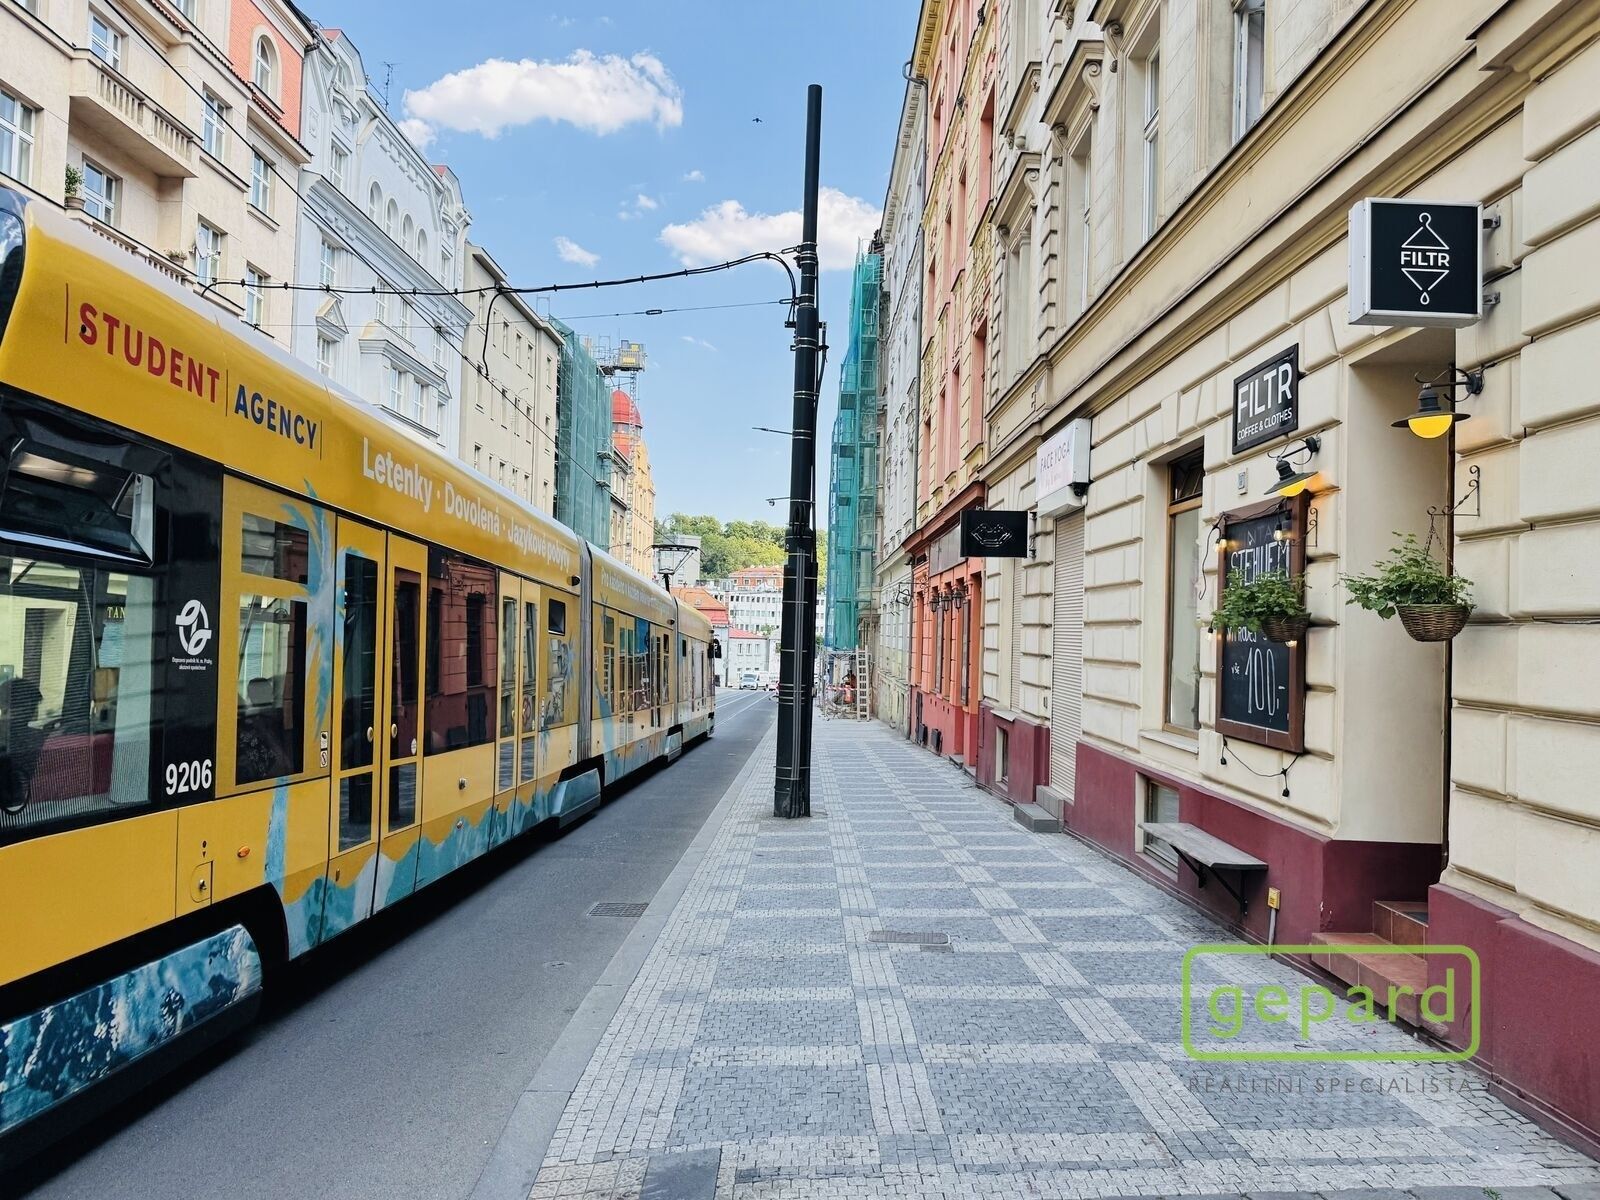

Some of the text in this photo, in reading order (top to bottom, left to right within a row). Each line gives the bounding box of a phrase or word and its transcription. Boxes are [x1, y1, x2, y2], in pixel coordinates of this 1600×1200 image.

[1400, 251, 1450, 267] FILTR
[79, 302, 317, 449] STUDENT AGENCY
[1237, 362, 1293, 424] FILTR
[1237, 407, 1293, 441] COFFEE & CLOTHES
[363, 437, 571, 572] Letenky Dovolená Jazykové pobyty
[165, 758, 212, 795] 9206
